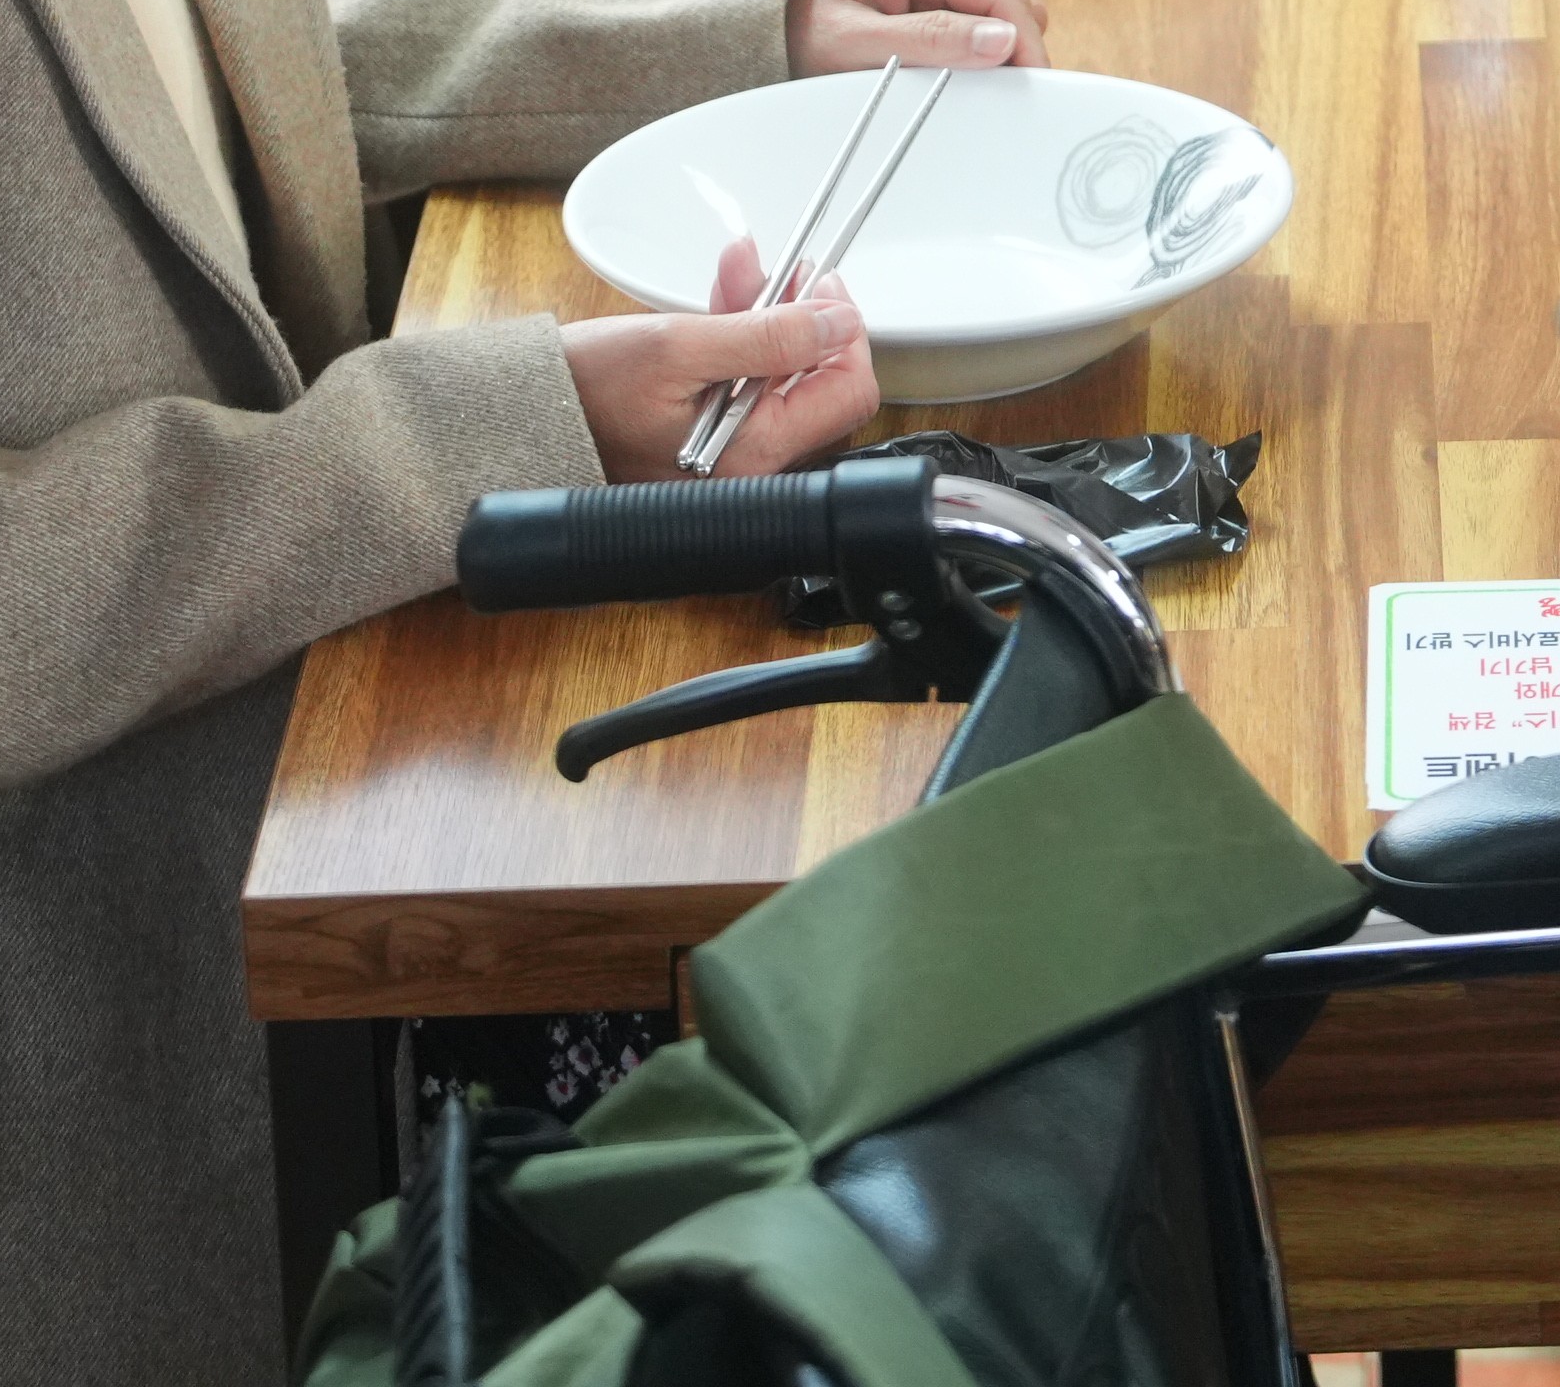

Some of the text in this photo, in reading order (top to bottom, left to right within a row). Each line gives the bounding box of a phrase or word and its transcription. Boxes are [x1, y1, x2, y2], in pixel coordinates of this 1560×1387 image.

[1406, 631, 1453, 651] 받기
[1480, 656, 1553, 676] 남기기
[1448, 712, 1497, 731] 검색
[1423, 752, 1515, 778] 벤트
